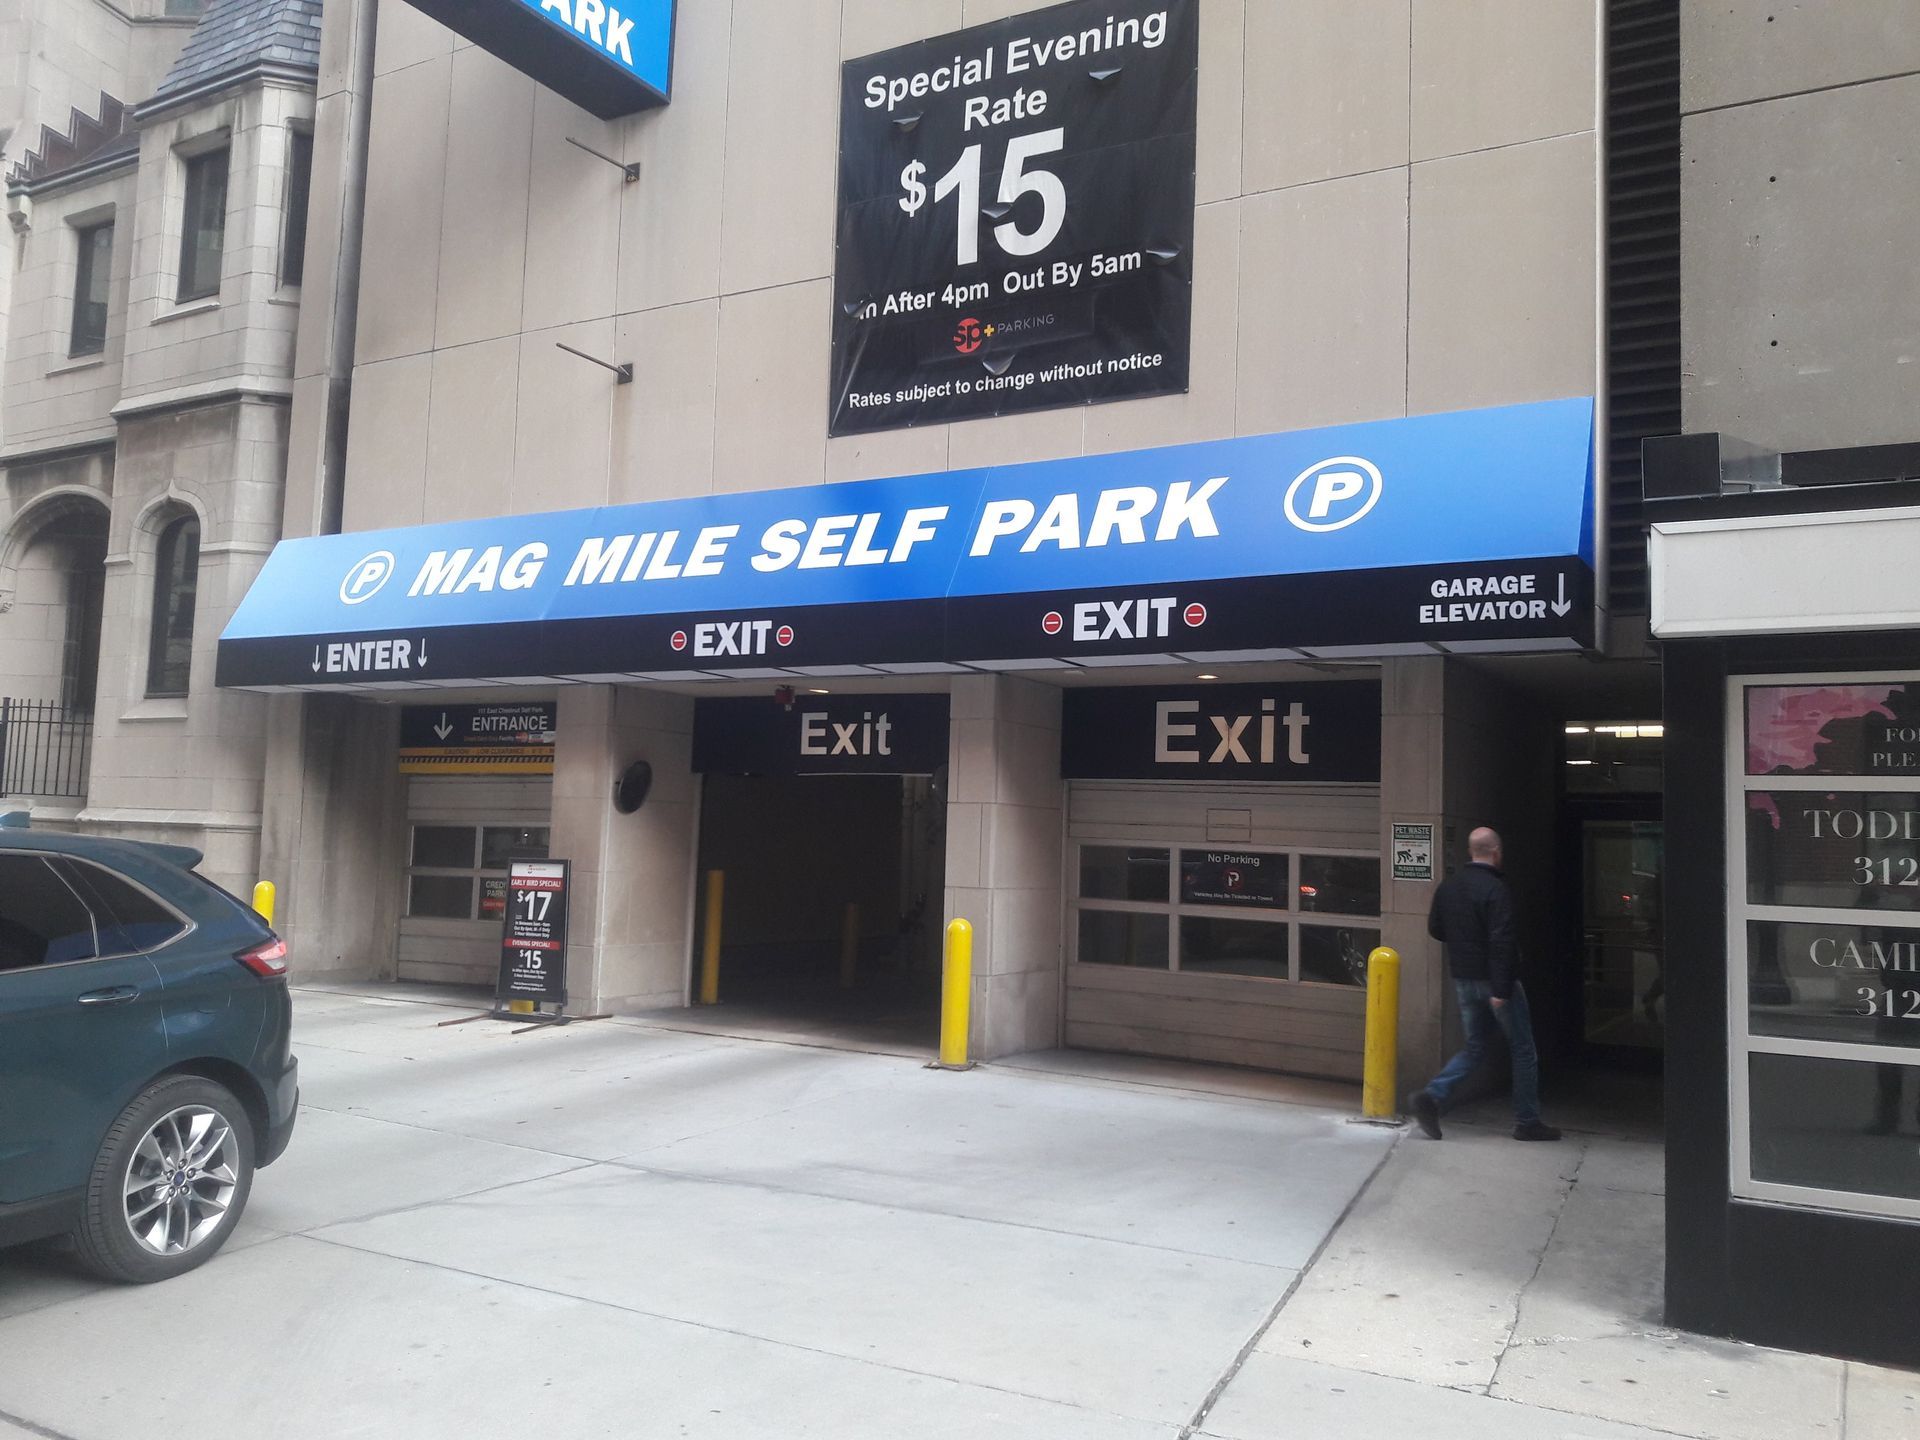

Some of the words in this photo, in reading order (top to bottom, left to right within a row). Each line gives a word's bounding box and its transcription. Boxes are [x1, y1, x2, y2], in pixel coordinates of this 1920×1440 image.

[865, 47, 994, 111] Special
[1007, 11, 1168, 75] Evening
[964, 87, 1048, 132] Rate
[899, 127, 1067, 266] $15
[860, 301, 877, 319] n
[883, 290, 936, 316] After
[942, 283, 989, 309] 4pm
[1004, 269, 1045, 294] Out
[1053, 261, 1083, 288] By
[1091, 251, 1141, 278] 5am
[997, 314, 1055, 334] PARKING
[849, 391, 892, 409] Rates
[895, 380, 952, 404] subject
[955, 380, 971, 395] to
[976, 373, 1035, 392] change
[1040, 361, 1103, 384] without
[1108, 353, 1163, 373] notice
[408, 543, 548, 597] MAG
[564, 525, 740, 586] MILE
[751, 506, 950, 573] SELF
[969, 477, 1230, 557] PARK
[1430, 574, 1536, 598] GARAGE
[1074, 598, 1177, 641] EXIT
[1419, 600, 1547, 624] ELEVATOR
[326, 639, 412, 673] ENTER
[694, 621, 773, 657] EXIT
[472, 716, 548, 731] ENTRANCE
[801, 711, 892, 756] Exit
[1154, 698, 1310, 764] Exit
[1395, 826, 1407, 834] PET
[1408, 826, 1430, 834] WASTE
[1207, 853, 1221, 863] No
[1224, 854, 1260, 867] Parking
[517, 889, 552, 921] $17
[519, 949, 542, 969] $15
